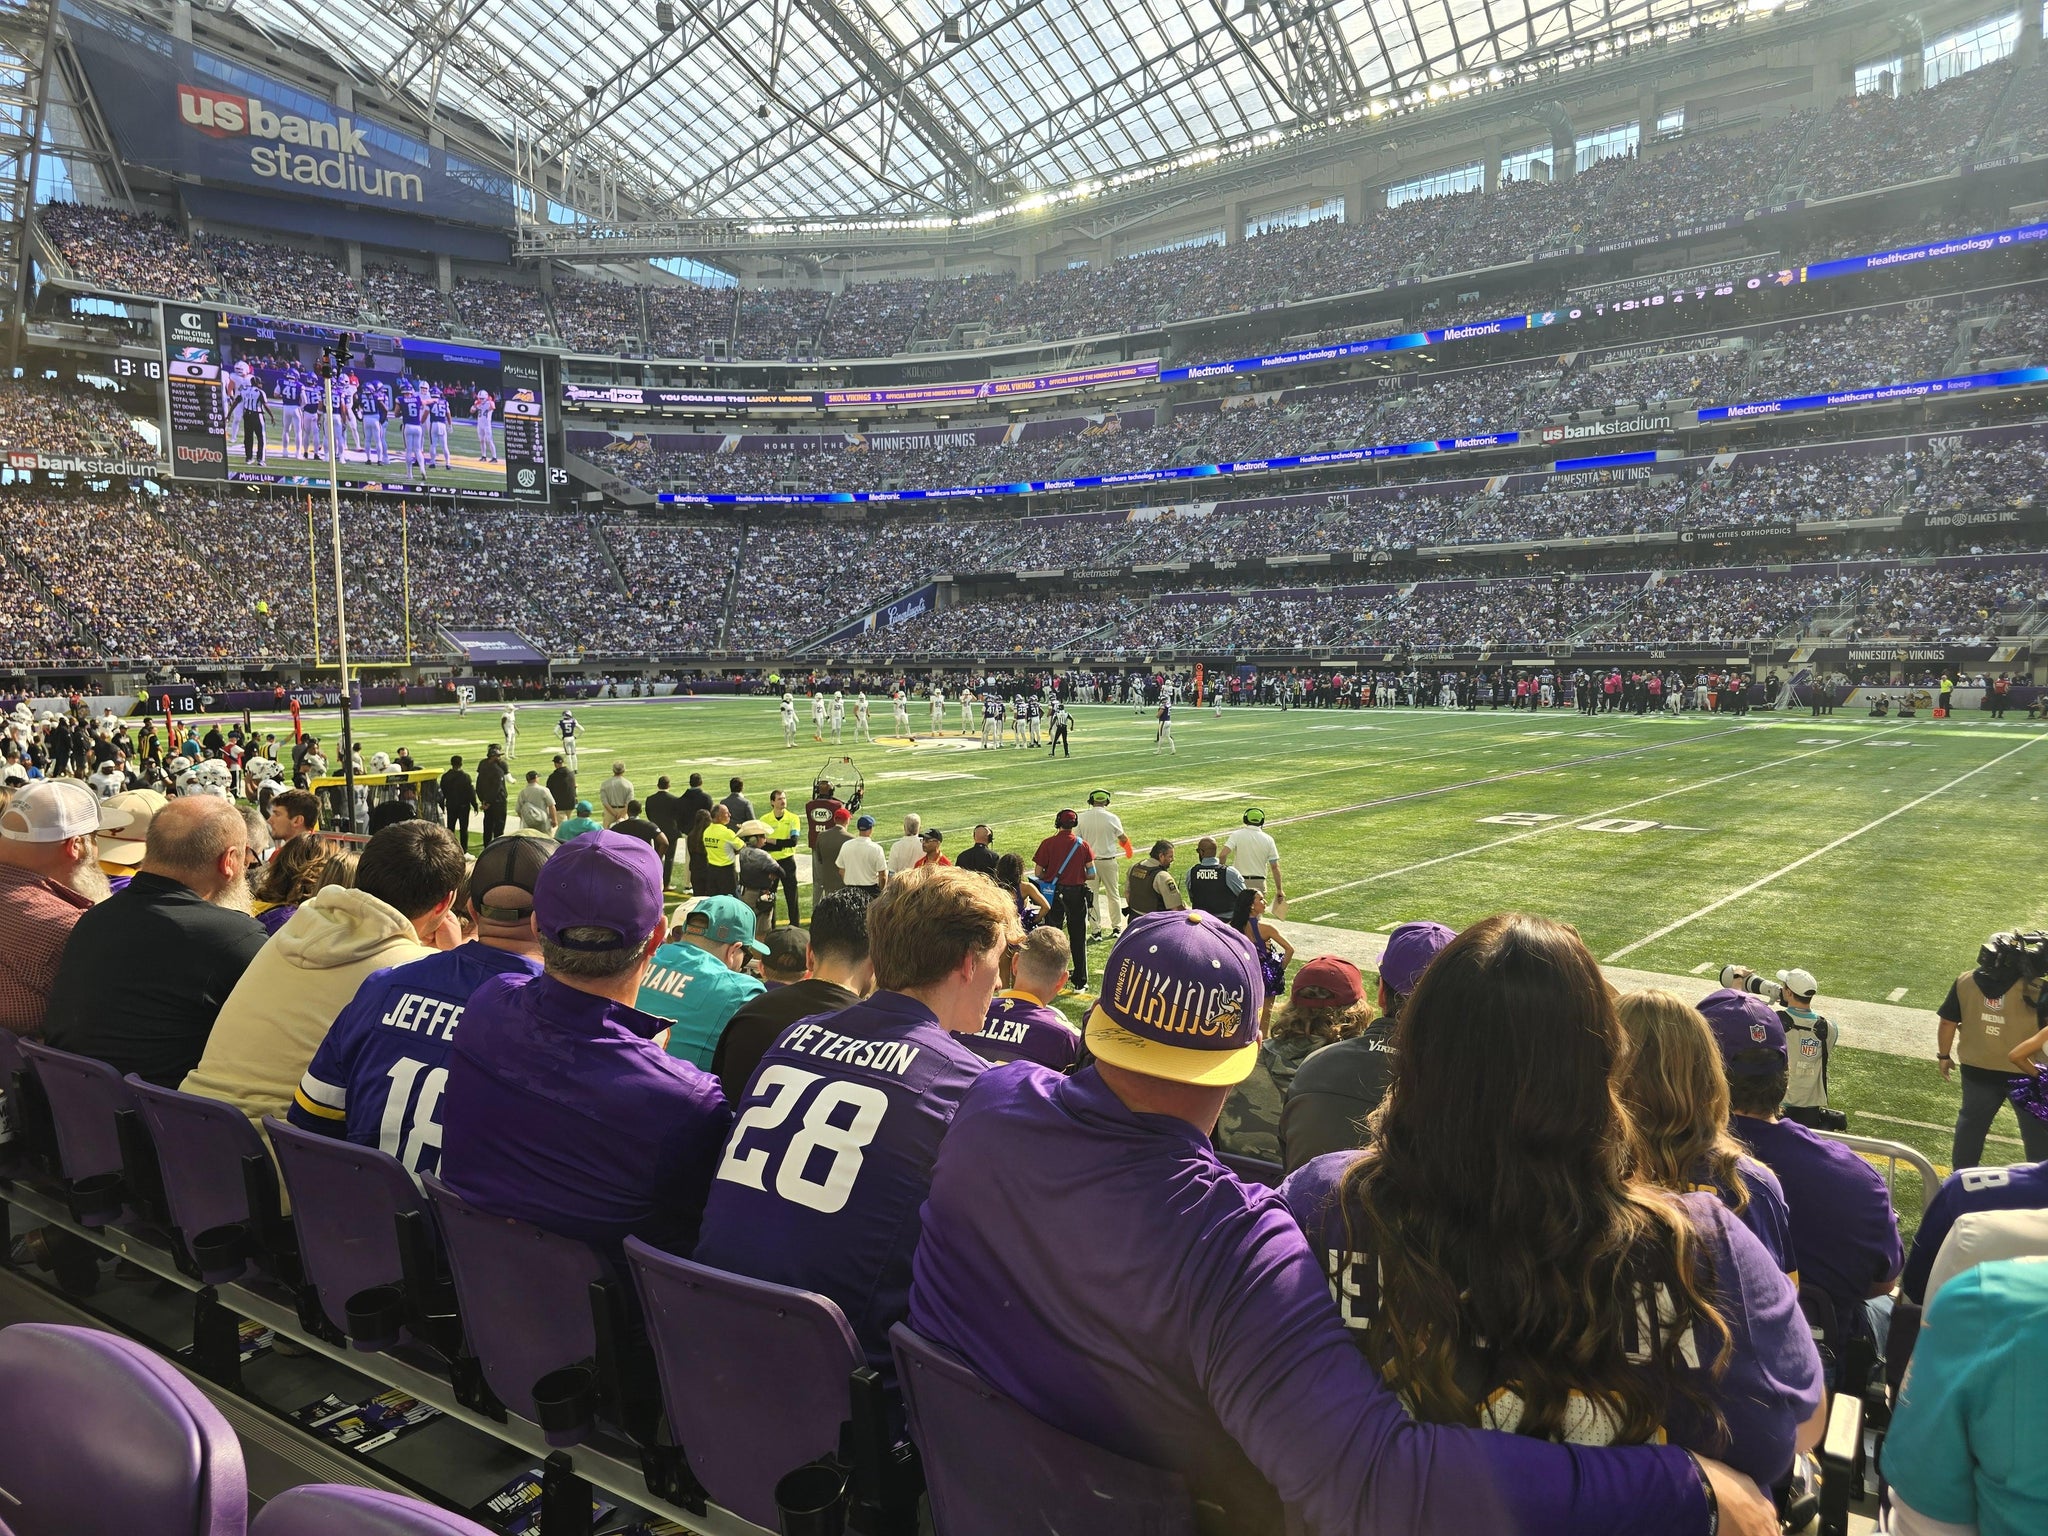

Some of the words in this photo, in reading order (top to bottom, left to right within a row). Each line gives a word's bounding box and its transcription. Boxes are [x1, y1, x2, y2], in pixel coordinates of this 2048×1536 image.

[1974, 159, 2006, 171] MARSHALL
[2009, 156, 2018, 164] 70
[251, 144, 423, 202] stadium
[1771, 205, 1787, 214] FINKS
[1599, 241, 1632, 253] MINNESOTA
[1635, 235, 1659, 246] VIKINGS
[1677, 228, 1693, 237] RING
[1695, 226, 1703, 234] OF
[1705, 222, 1726, 232] HONOR
[1866, 250, 1925, 269] Healthcare
[1928, 237, 1994, 259] technology
[1998, 233, 2011, 244] to
[2018, 227, 2048, 242] keep
[1569, 309, 1581, 319] 0
[1612, 295, 1664, 312] 13:18
[1674, 295, 1683, 303] 4
[1695, 292, 1705, 300] 7
[1714, 287, 1733, 296] 49
[1747, 278, 1761, 289] 0
[171, 334, 214, 345] ORTHOPEDICS
[174, 328, 190, 336] TWIN
[191, 330, 211, 338] CITIES
[257, 328, 276, 339] SKOL
[1188, 363, 1235, 379] Medtronic
[1262, 354, 1298, 367] Healthcare
[1299, 349, 1338, 363] technology
[1339, 347, 1347, 355] to
[1444, 322, 1501, 341] Medtronic
[114, 358, 161, 379] 13:18
[187, 366, 203, 376] 0
[995, 384, 1010, 392] SKOL
[1011, 381, 1036, 391] VIKINGS
[1049, 377, 1067, 386] OFFICIAL
[1068, 376, 1078, 384] BEER
[1094, 371, 1118, 379] MINNESOTA
[1119, 368, 1137, 377] VIKINGS
[282, 385, 296, 400] 41
[828, 394, 845, 402] SKOL
[846, 393, 871, 402] VIKINGS
[957, 388, 975, 396] VIKINGS
[1727, 402, 1781, 418] Medtronic
[1827, 390, 1873, 405] Healthcare
[1876, 384, 1928, 399] technology
[1932, 383, 1942, 391] to
[1947, 380, 1971, 390] keep
[361, 399, 376, 412] 31
[408, 403, 417, 417] 6
[431, 404, 446, 417] 45
[517, 404, 529, 413] 0
[803, 442, 815, 450] OF
[872, 435, 931, 450] MINNESOTA
[934, 433, 976, 449] VIKINGS
[1455, 436, 1498, 448] Medtronic
[1233, 461, 1268, 471] Medtronic
[1300, 454, 1330, 463] Healthcare
[1331, 451, 1363, 460] technology
[551, 469, 567, 484] 25
[1044, 480, 1075, 489] Medtronic
[1101, 475, 1127, 483] Healthcare
[1128, 472, 1155, 481] technology
[674, 495, 709, 503] Medtronic
[869, 493, 900, 501] Medtronic
[925, 489, 950, 497] Healthcare
[951, 488, 976, 496] technology
[1925, 515, 1951, 527] LAND
[1999, 511, 2020, 522] INC.
[1717, 530, 1739, 540] CITIES
[1740, 526, 1792, 538] ORTHOPEDICS
[1072, 568, 1121, 579] ticketmaster
[1650, 650, 1666, 659] SKOL
[1849, 650, 1896, 660] MINNESOTA
[1909, 650, 1945, 660] VIKINGS
[290, 694, 313, 705] SKOL
[987, 706, 995, 714] 41
[1196, 872, 1218, 880] POLICE
[1114, 958, 1131, 1002] MINNESOTA
[1981, 1013, 2006, 1024] MEDIA
[1985, 1025, 2000, 1036] 195
[780, 1024, 920, 1075] PETERSON
[1802, 1045, 1818, 1056] NFL
[716, 1064, 889, 1214] 28
